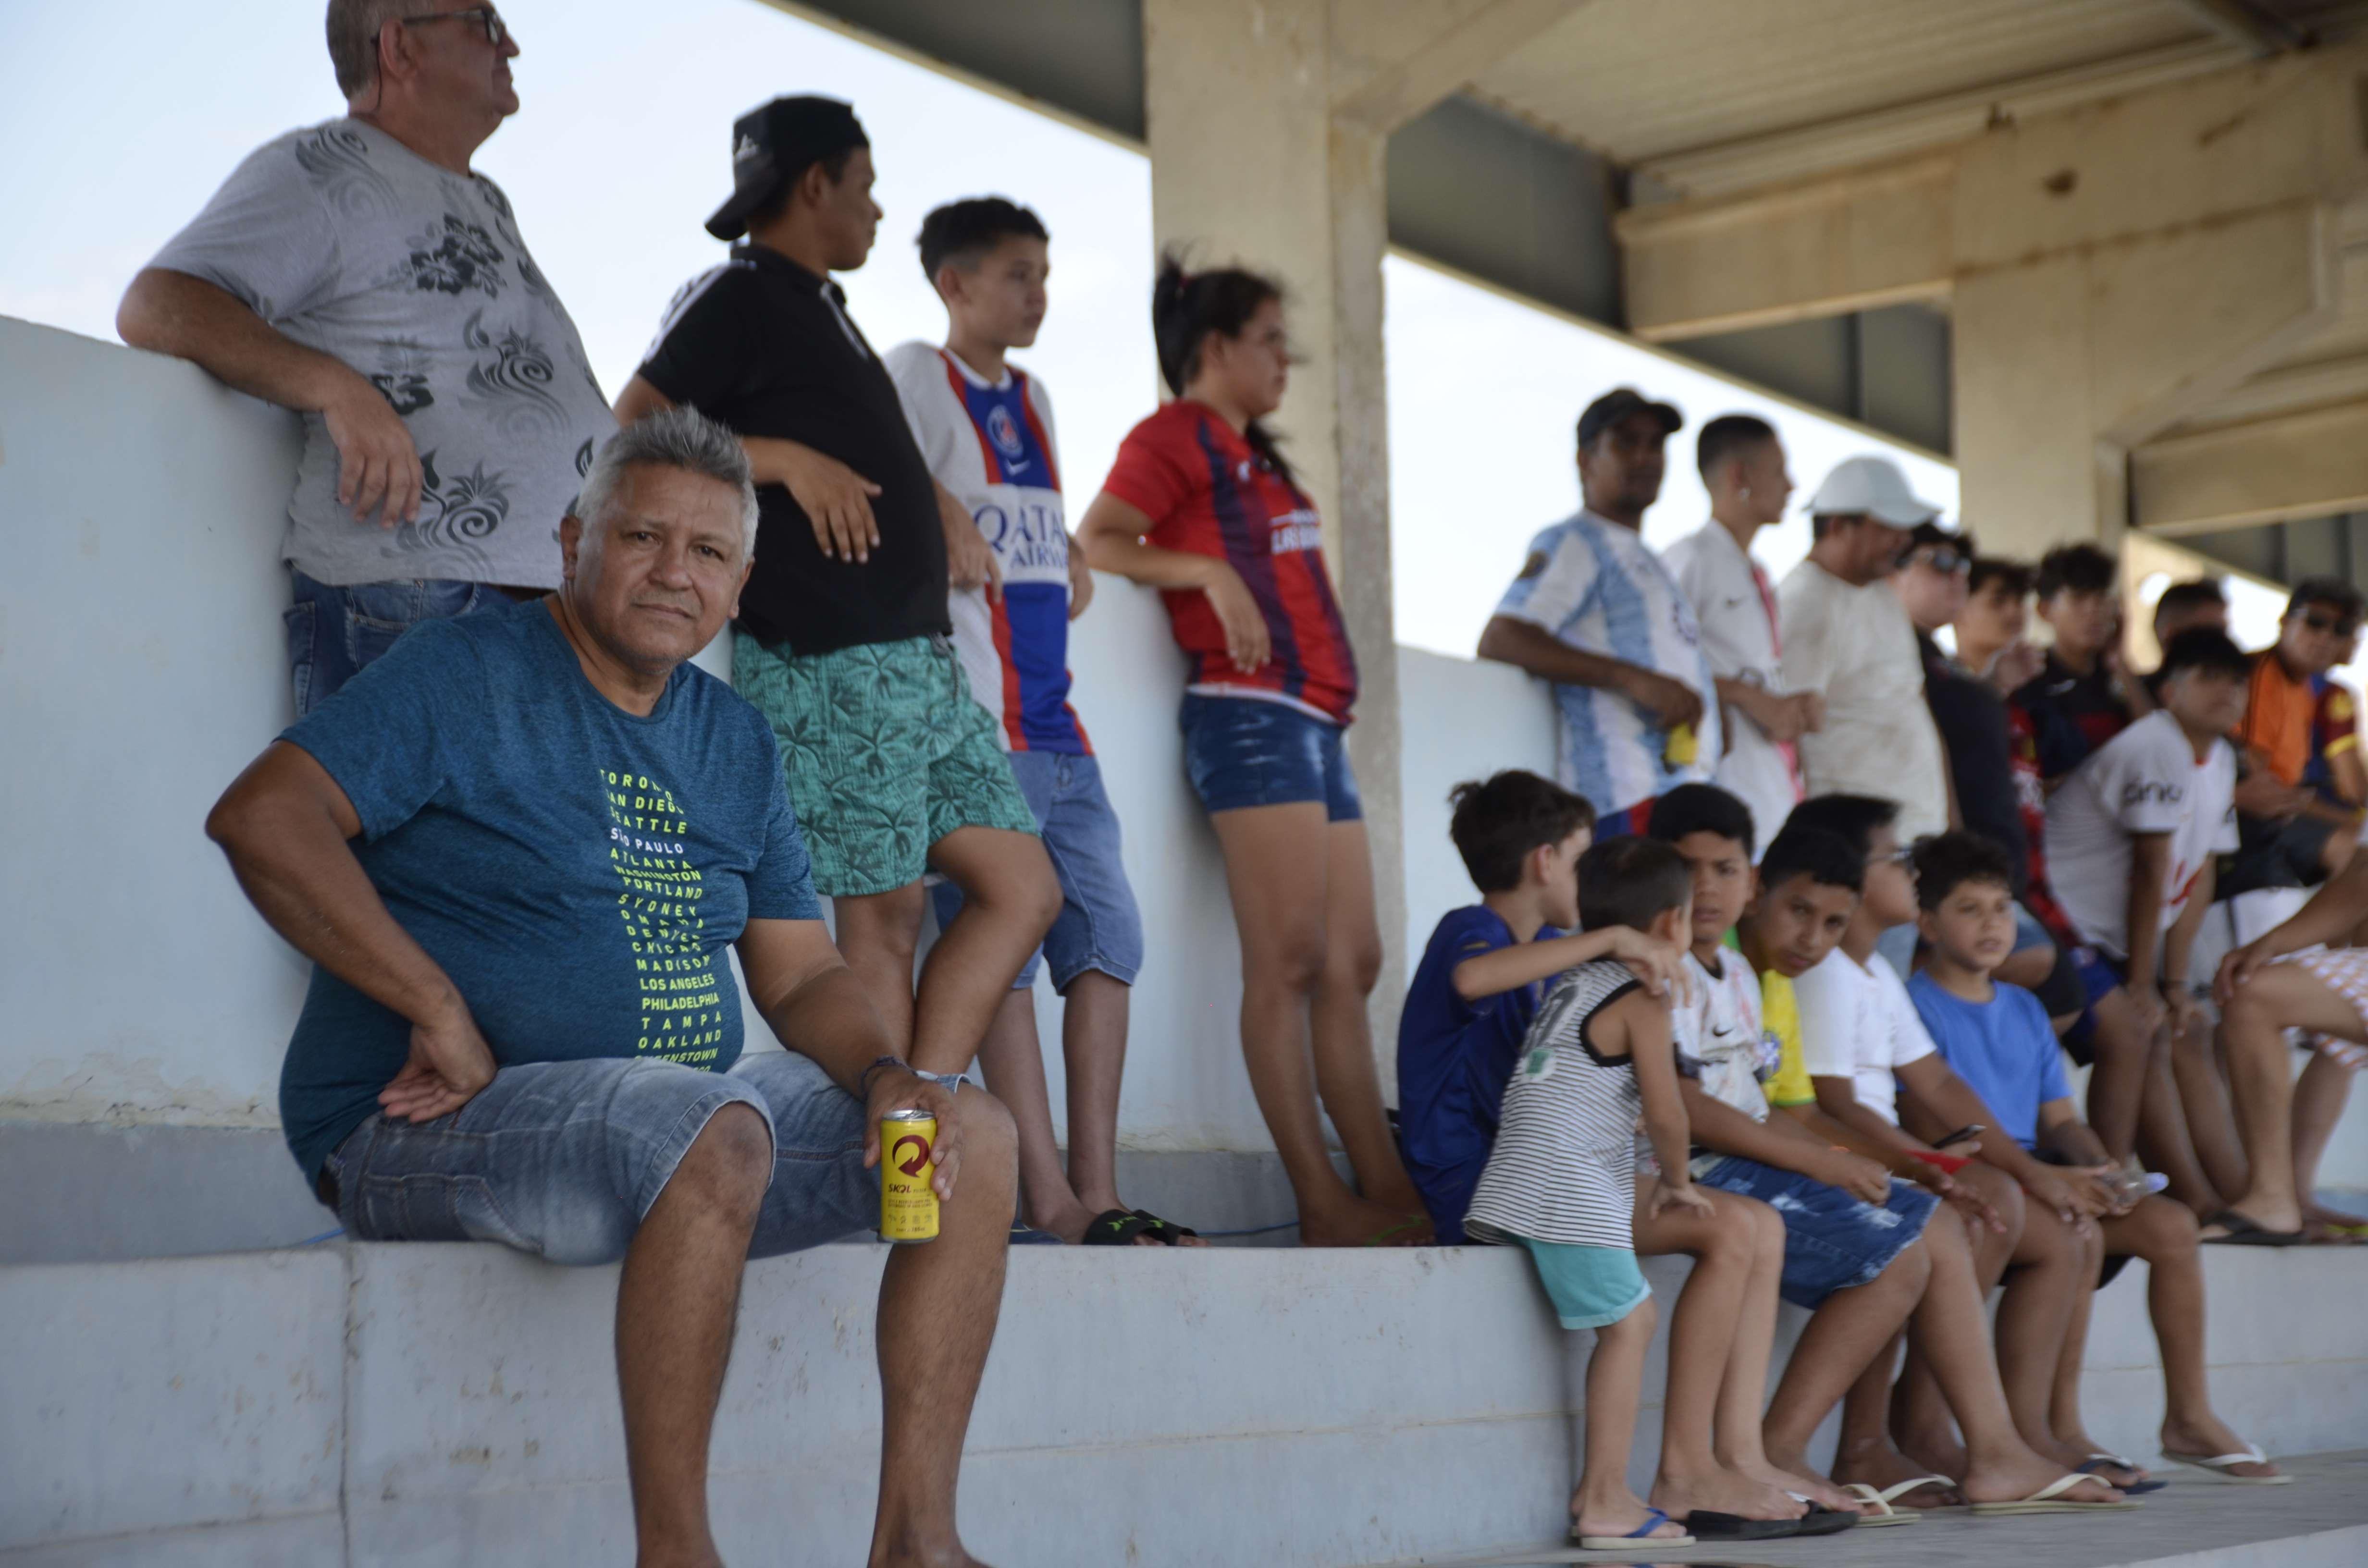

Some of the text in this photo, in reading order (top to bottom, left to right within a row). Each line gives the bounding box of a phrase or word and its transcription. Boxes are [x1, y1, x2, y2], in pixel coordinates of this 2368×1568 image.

[600, 769, 672, 802] TORONO
[610, 806, 687, 834] SEATTLE
[635, 838, 684, 854] PAULO
[610, 847, 692, 870] ATLANTA
[613, 864, 702, 882] WASHINGTON
[622, 876, 703, 899] PORTLAND
[618, 894, 696, 917] SYDNEY
[632, 942, 702, 954] CHICA
[636, 955, 710, 971] MADISON
[640, 973, 715, 991] LOS ANGELES
[642, 992, 720, 1010] PHILADELPHIA
[641, 1011, 721, 1030] TAMPA
[638, 1029, 721, 1049] OAKLAND
[634, 1048, 718, 1063] ENSTOWN
[888, 1183, 911, 1193] SKOL
